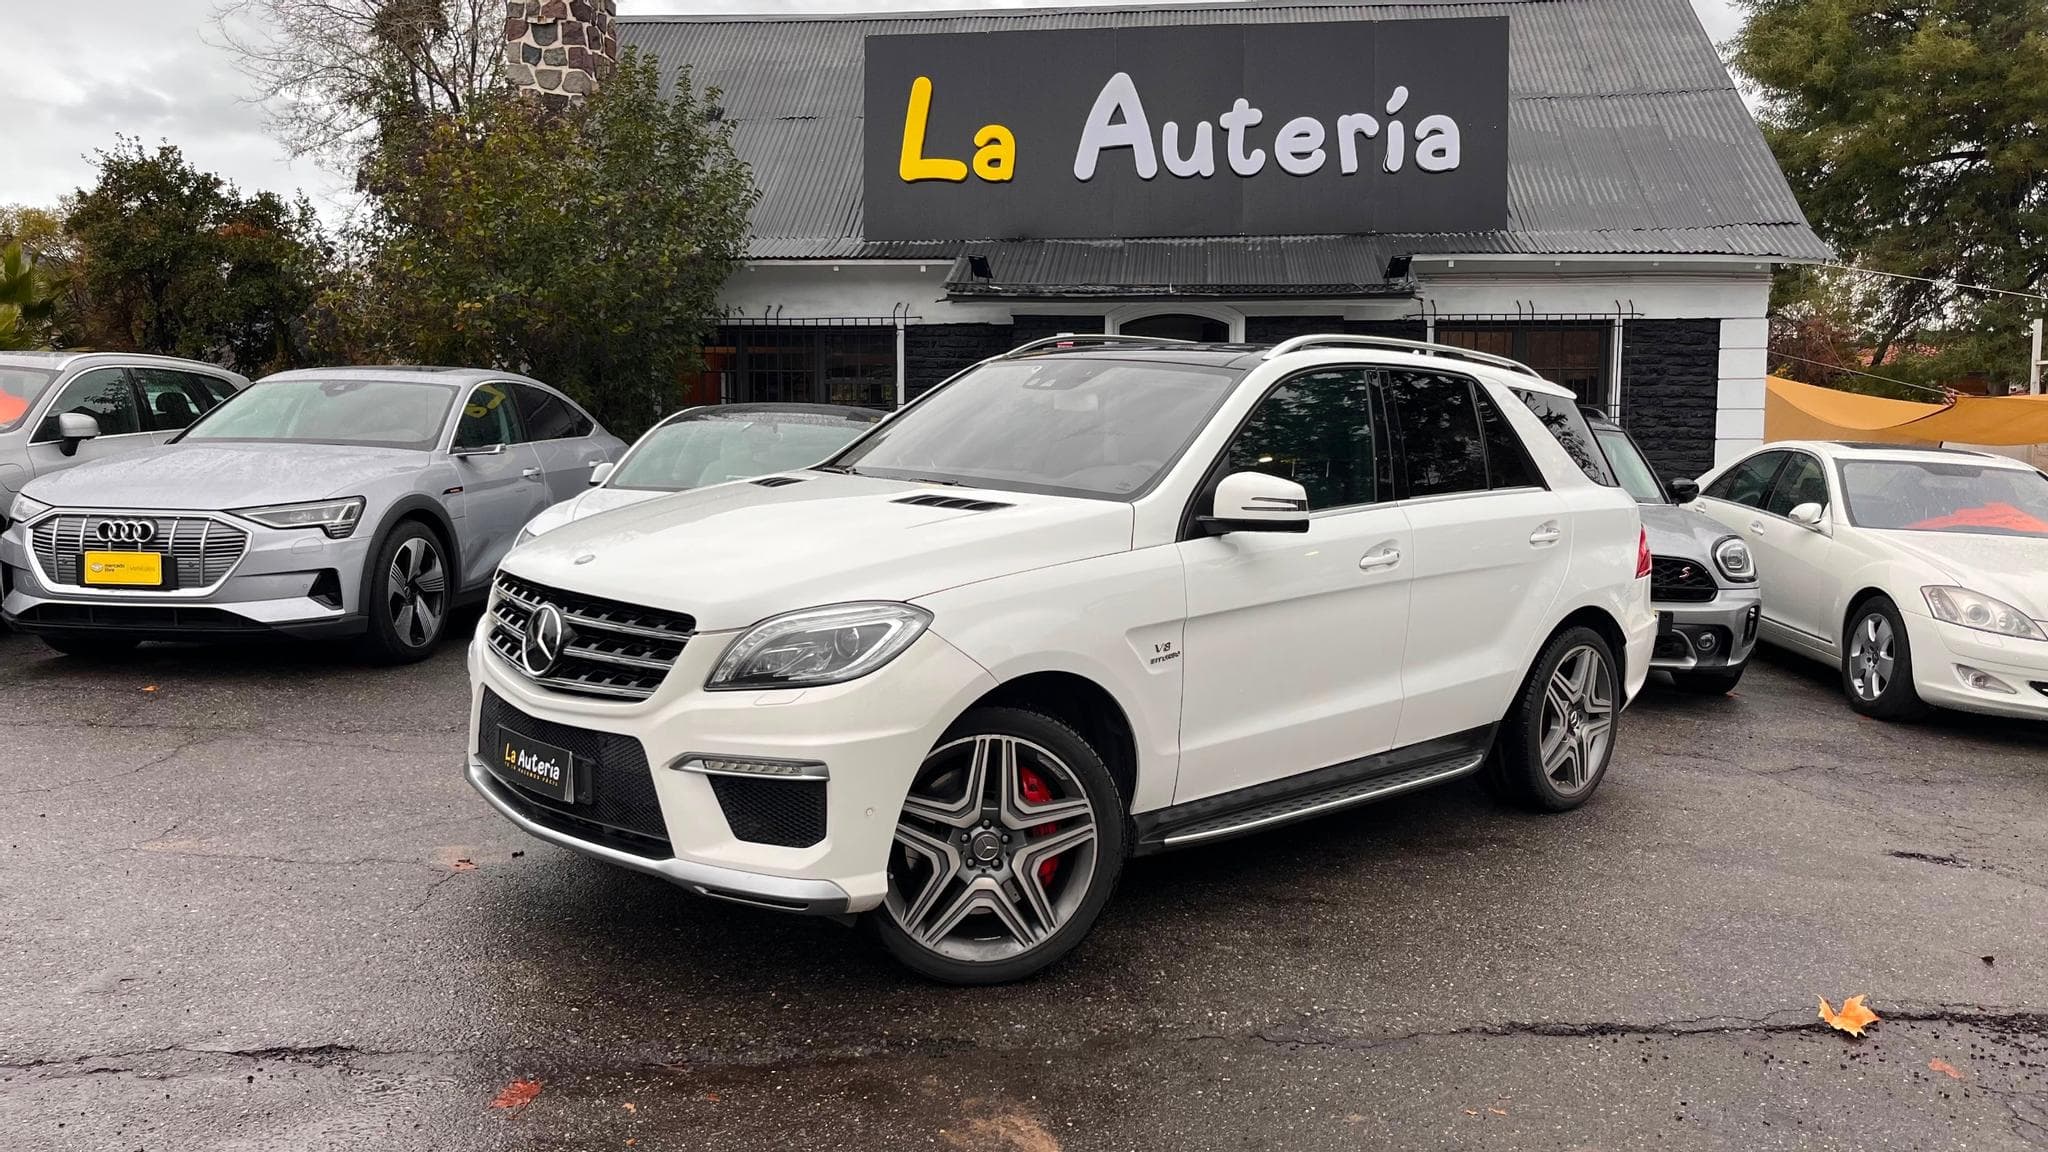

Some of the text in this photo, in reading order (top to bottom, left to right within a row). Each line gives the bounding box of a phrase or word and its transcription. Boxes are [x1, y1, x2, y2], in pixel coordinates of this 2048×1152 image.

[899, 72, 1461, 183] La Autería
[1679, 566, 1691, 578] S
[1155, 642, 1171, 653] V8
[505, 742, 560, 780] La Autería
